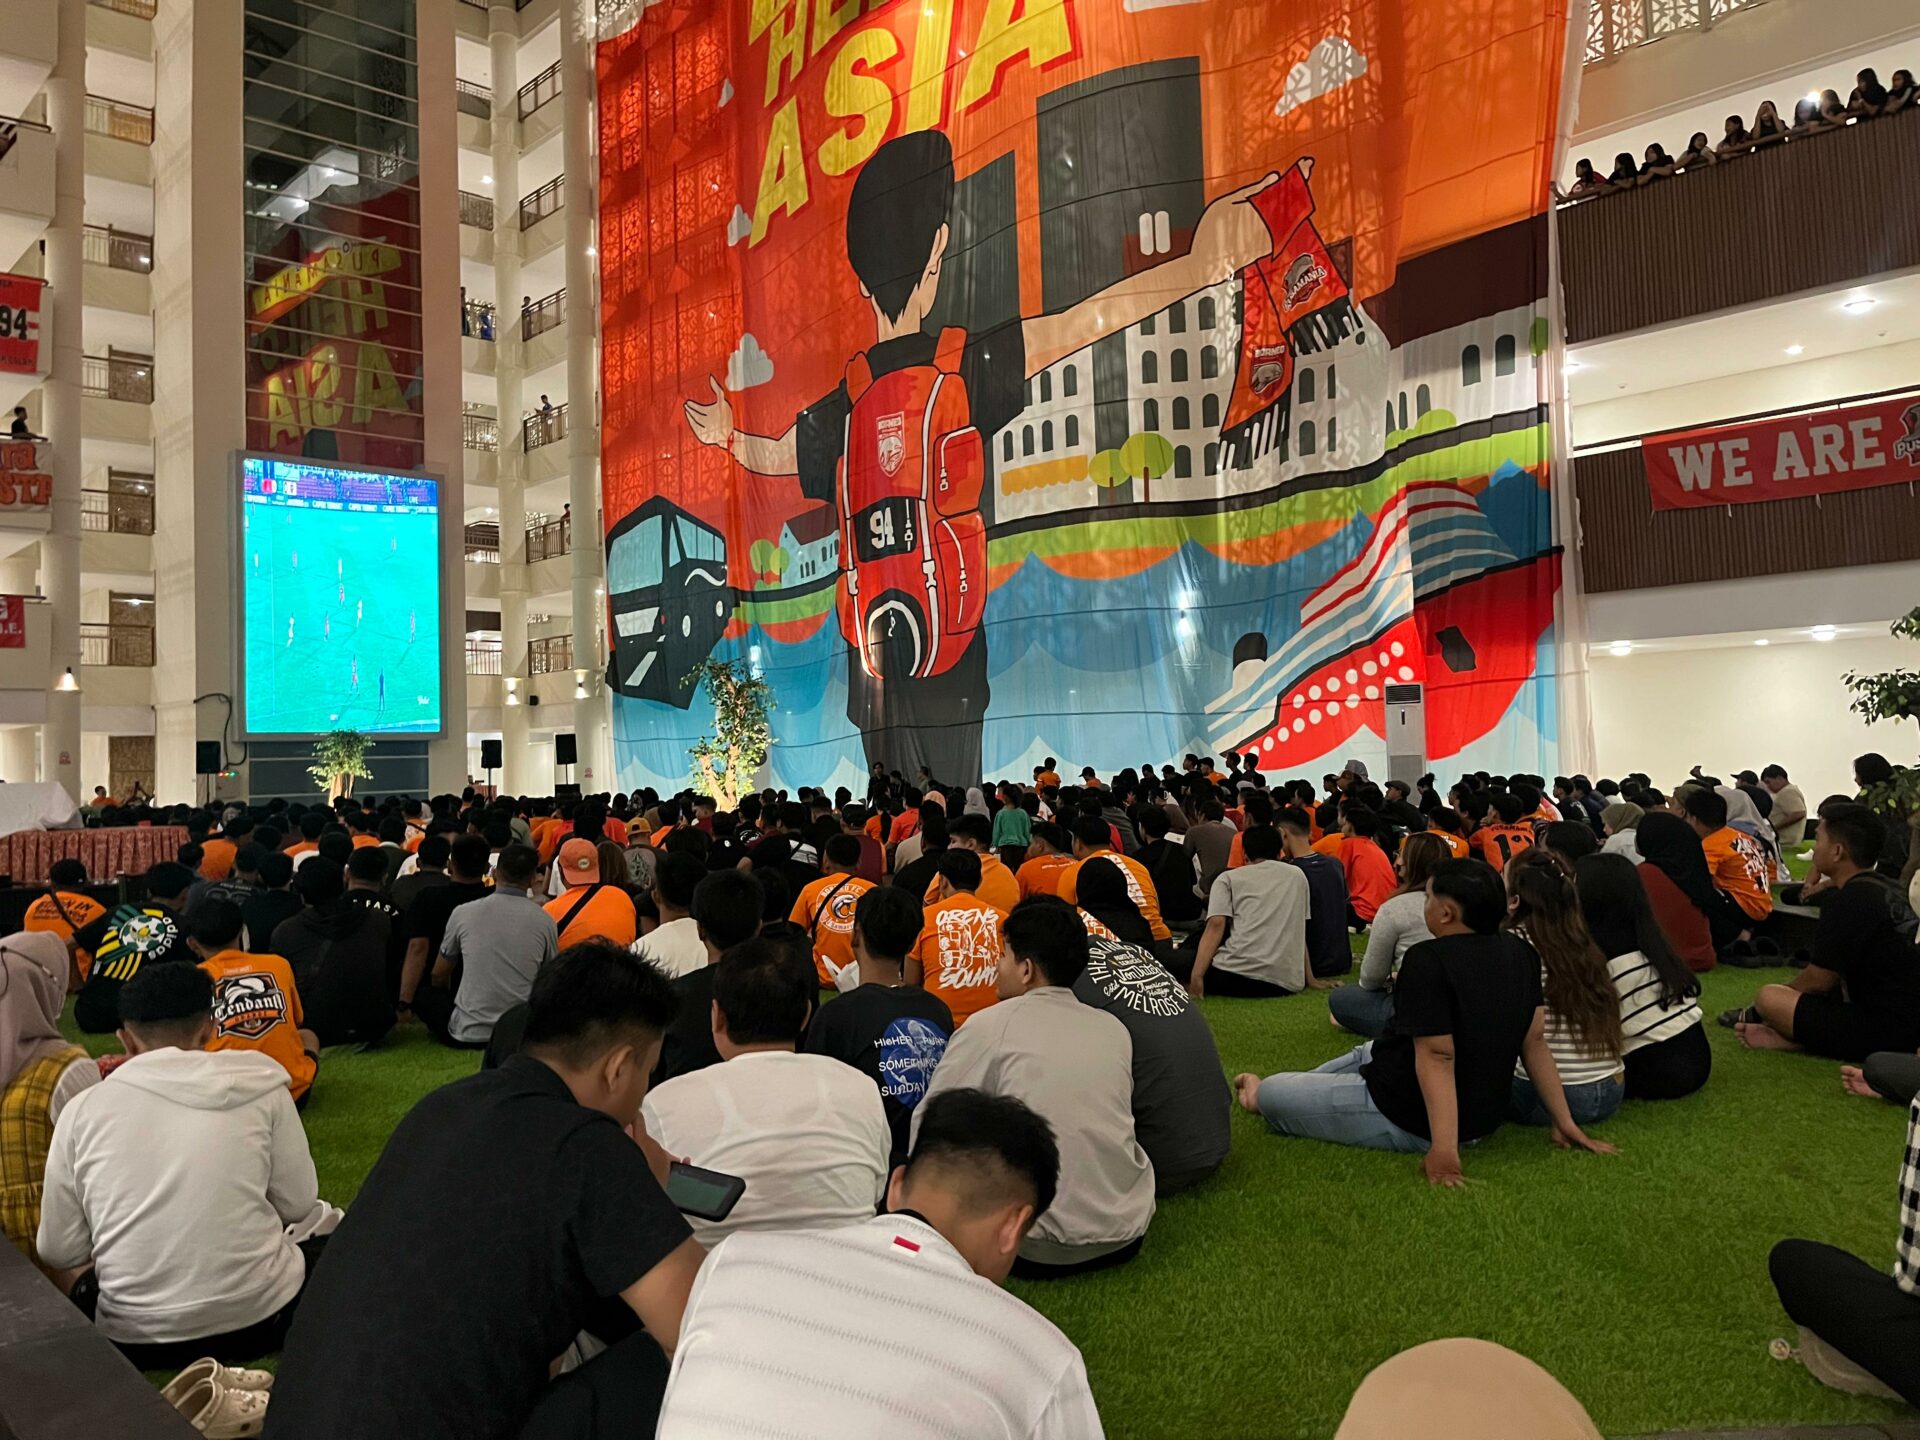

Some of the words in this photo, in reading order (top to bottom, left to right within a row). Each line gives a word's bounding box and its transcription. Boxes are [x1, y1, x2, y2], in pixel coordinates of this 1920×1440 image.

[748, 0, 1072, 249] ASIA
[1668, 437, 1753, 492] WE
[1773, 416, 1886, 481] ARE
[870, 507, 895, 549] 94
[365, 899, 400, 917] FAST
[148, 916, 179, 961] adidas
[1114, 986, 1185, 1016] MELROSE
[878, 1057, 938, 1072] SOMETHING
